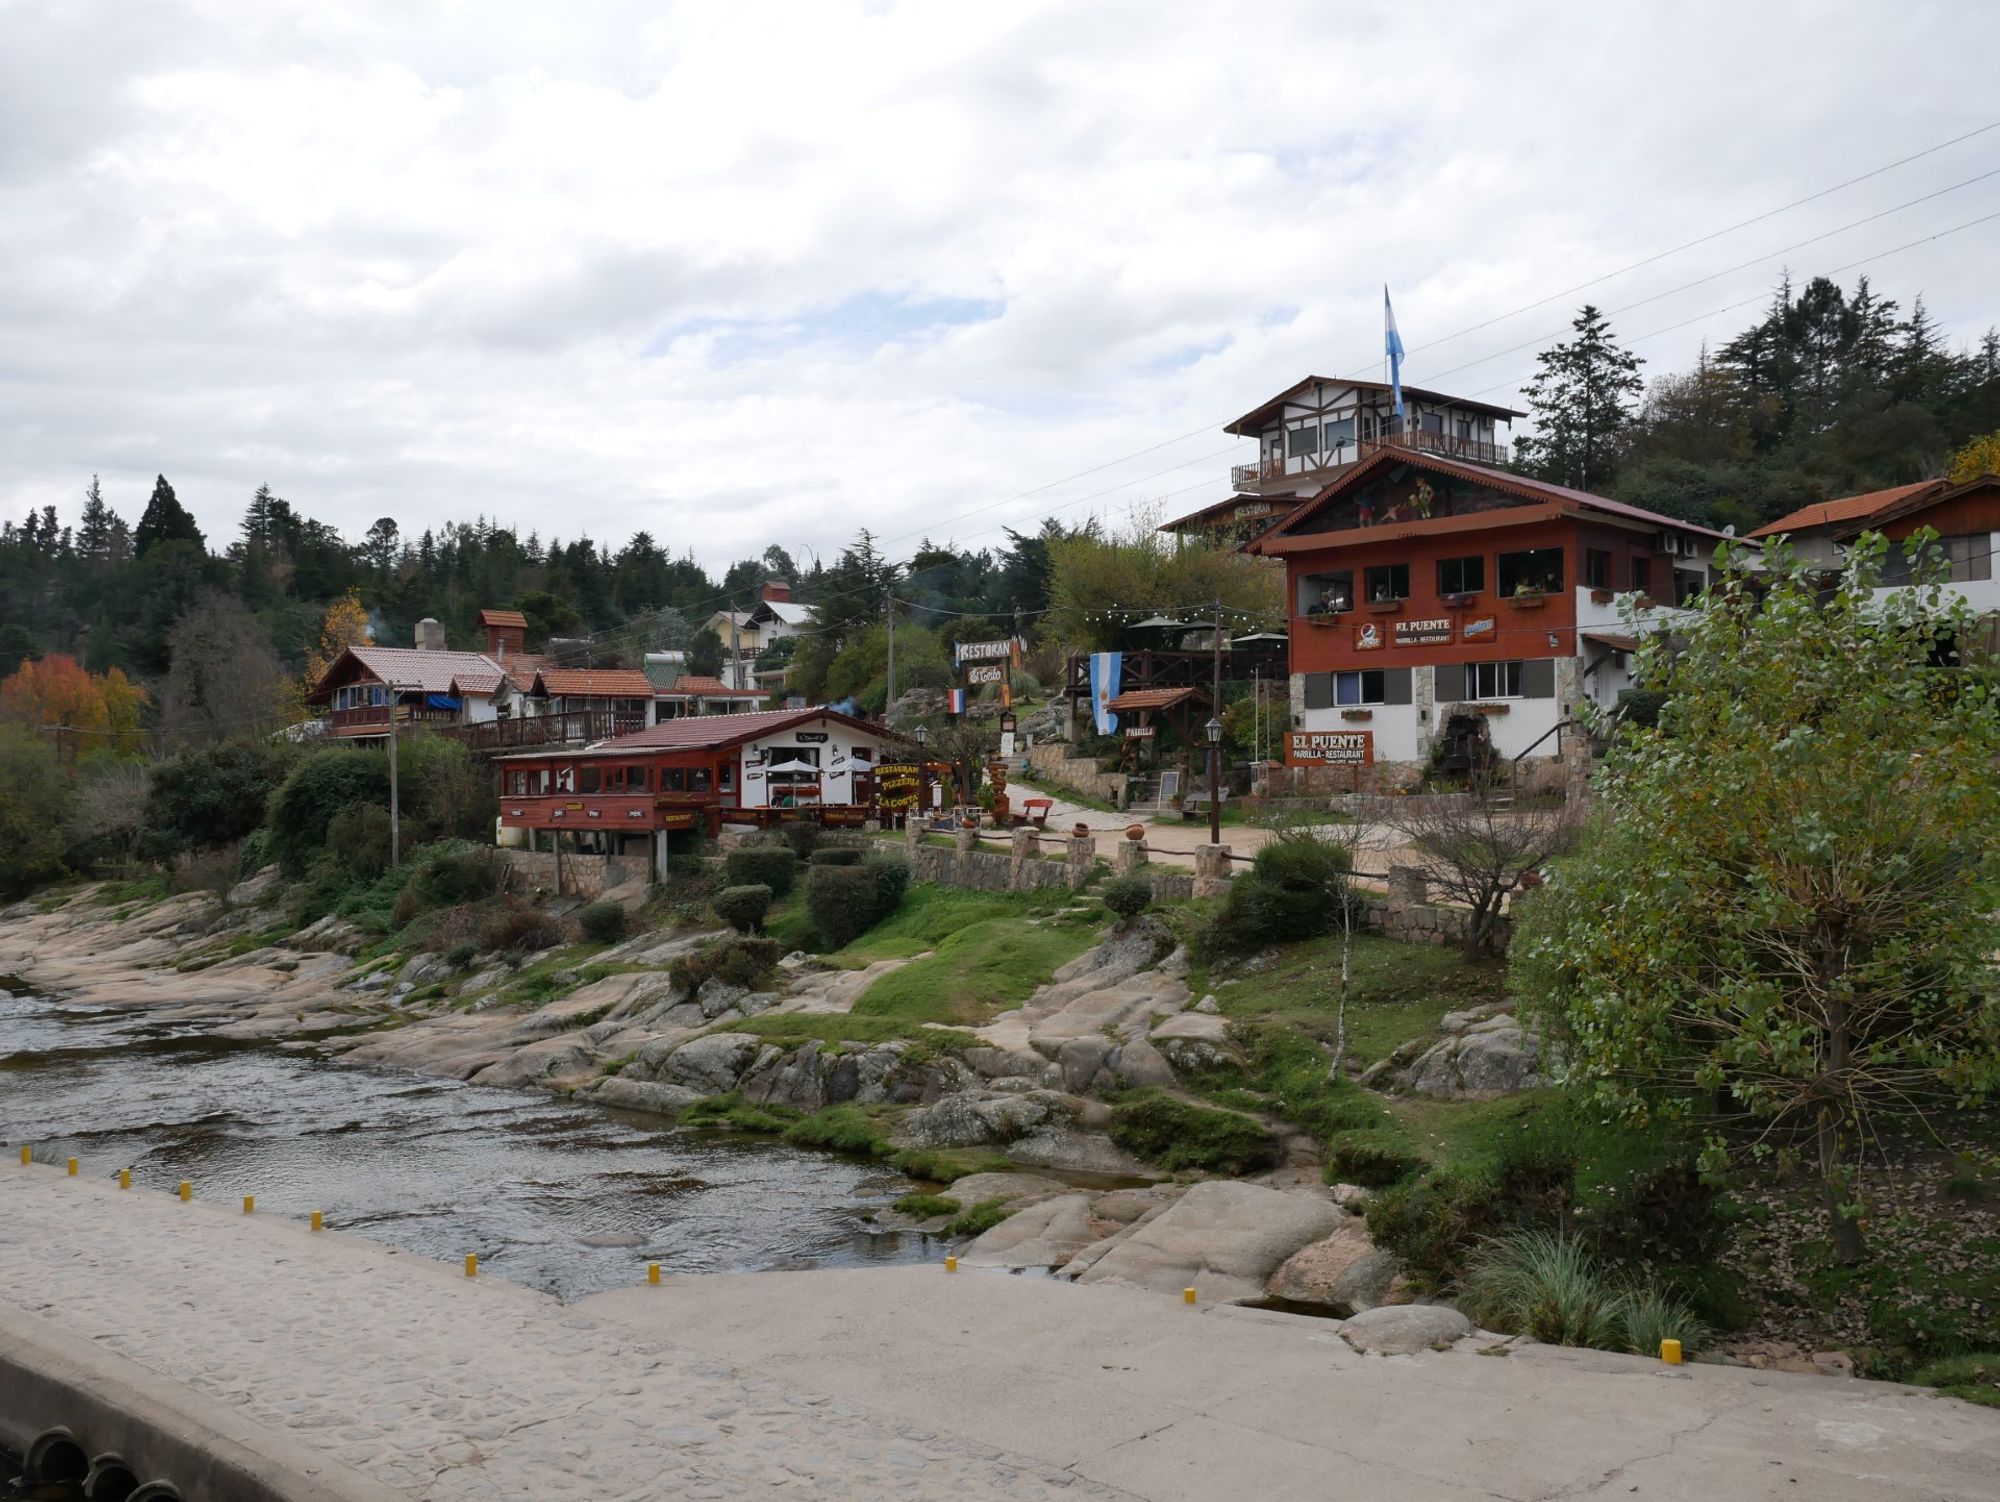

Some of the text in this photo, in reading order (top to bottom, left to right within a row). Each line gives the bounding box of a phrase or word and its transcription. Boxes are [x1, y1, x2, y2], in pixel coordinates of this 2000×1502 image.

[1396, 619, 1450, 632] EL PUENTE
[960, 642, 1010, 661] RESTORAN
[1292, 734, 1365, 749] EL PUENTE
[1293, 750, 1321, 758] PARRILLA
[1325, 750, 1365, 759] RESTAURANT
[875, 765, 919, 776] RESTAURAN
